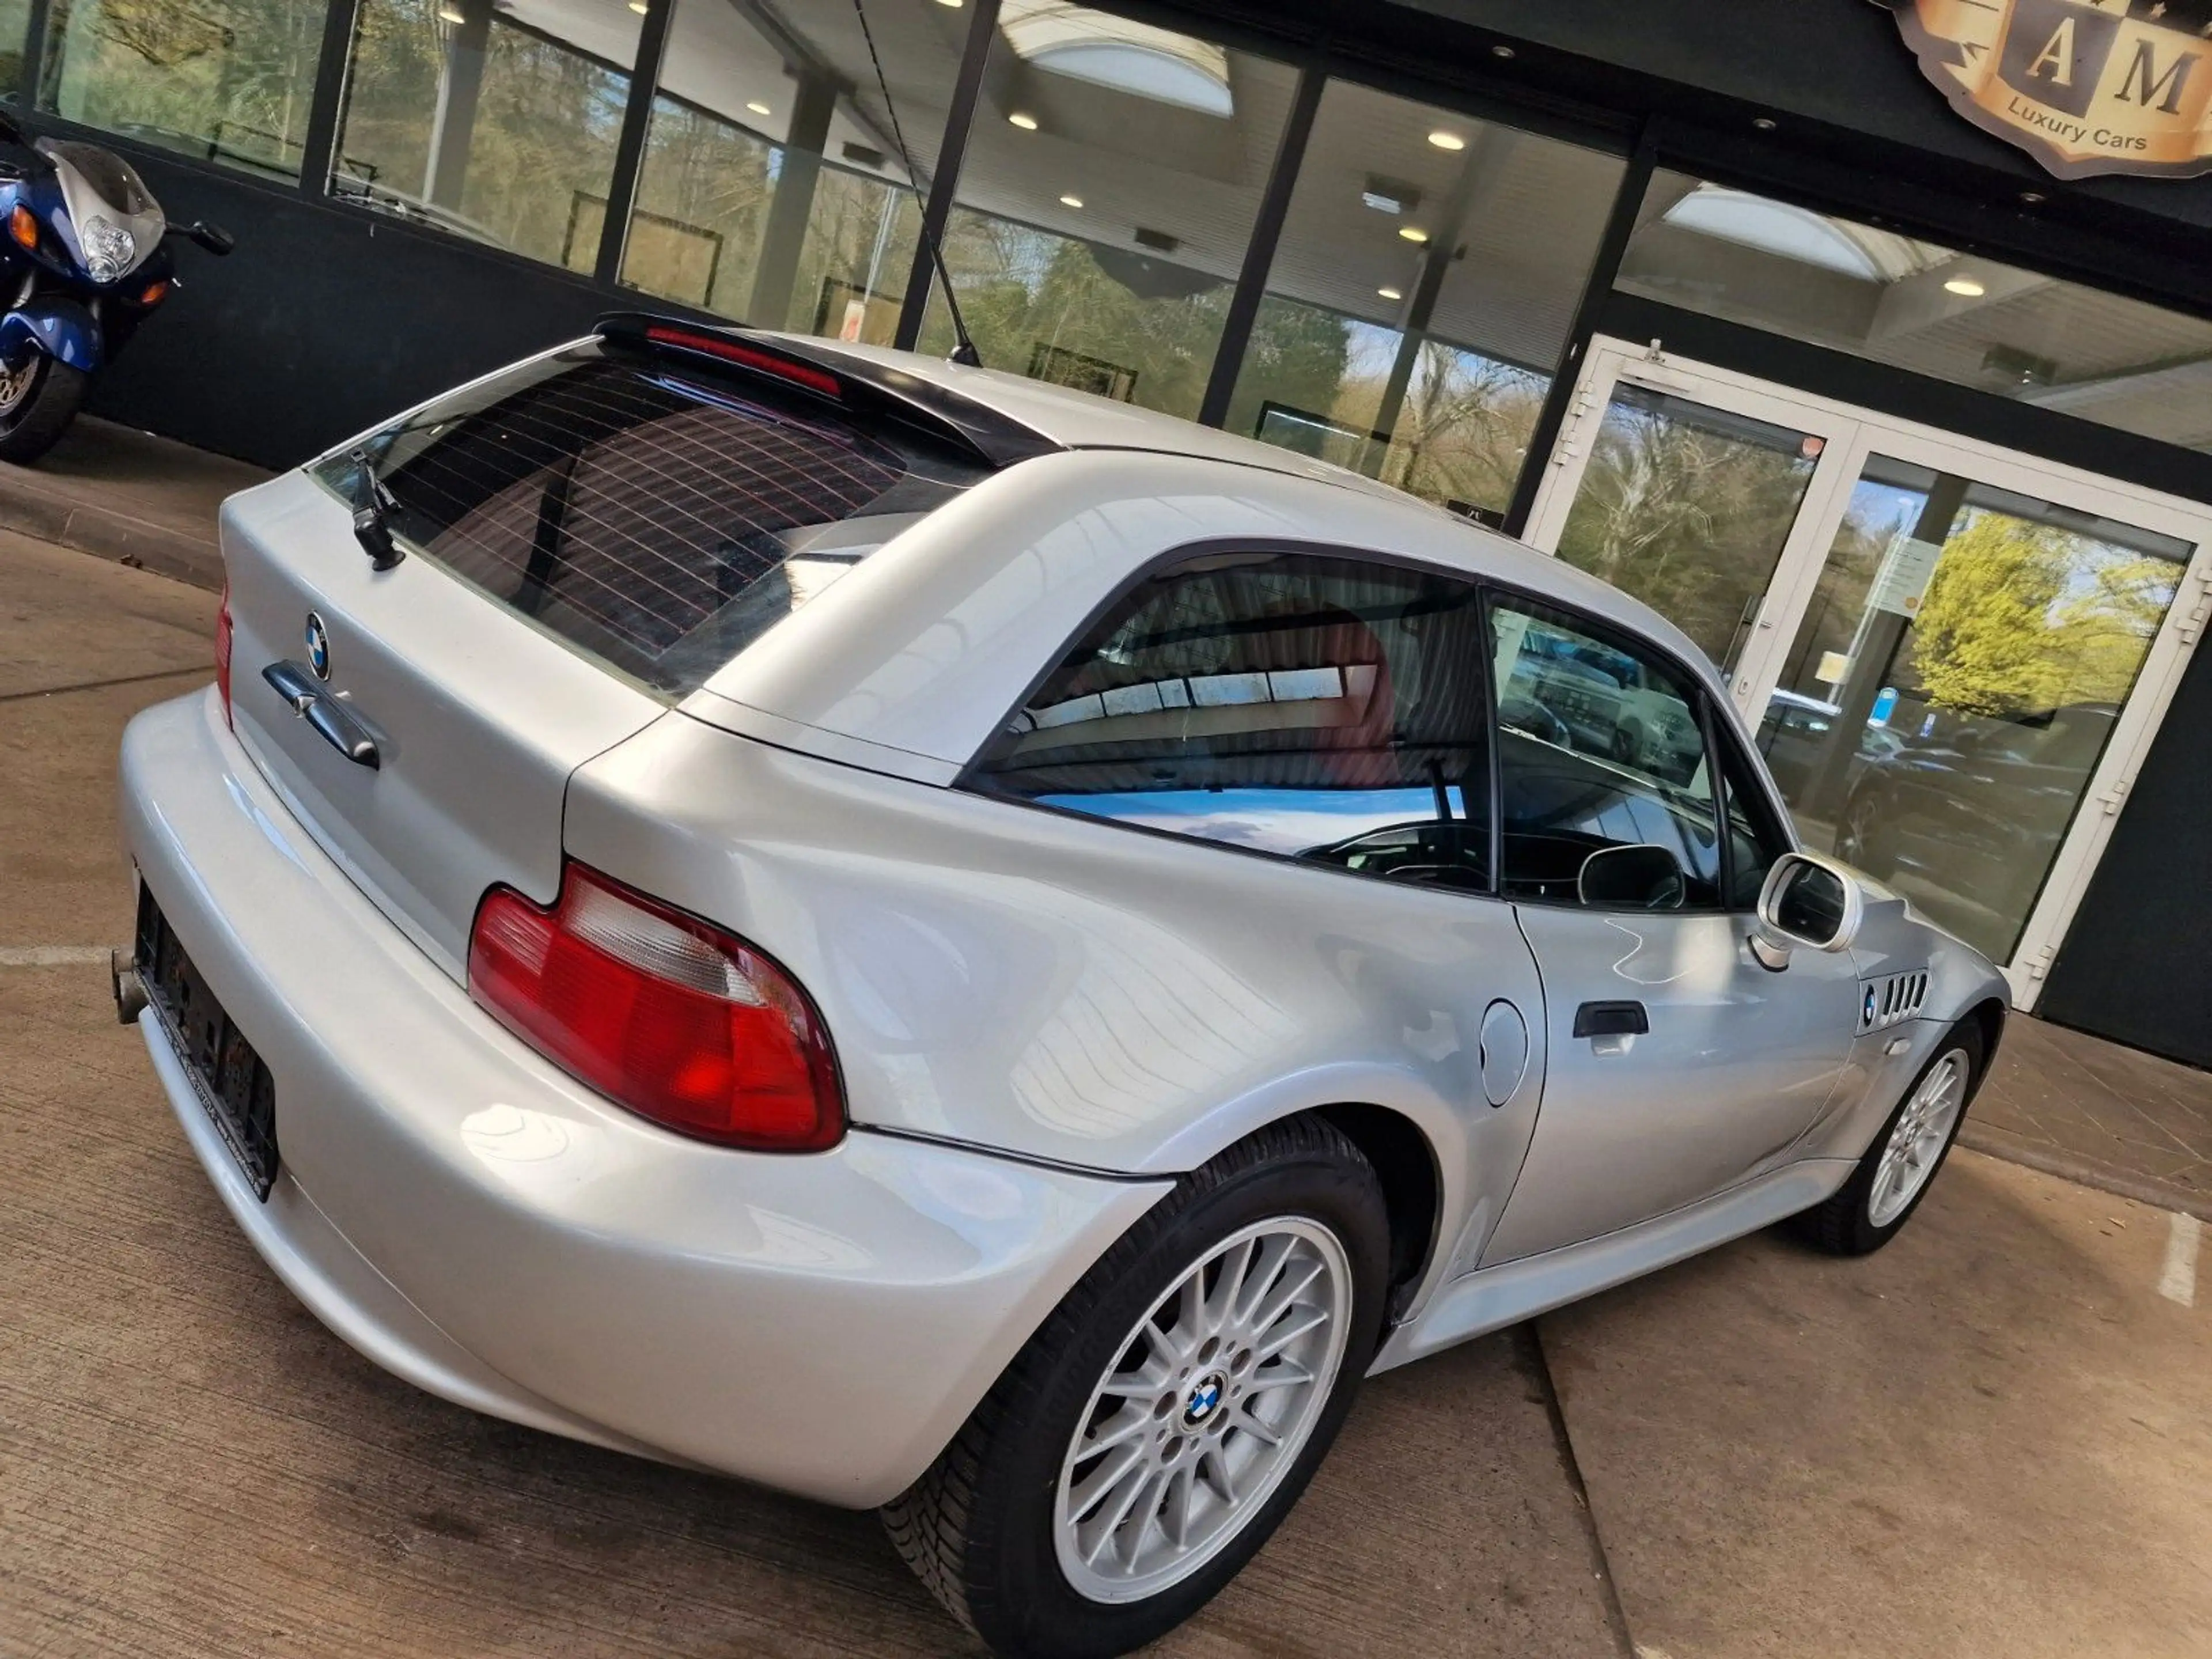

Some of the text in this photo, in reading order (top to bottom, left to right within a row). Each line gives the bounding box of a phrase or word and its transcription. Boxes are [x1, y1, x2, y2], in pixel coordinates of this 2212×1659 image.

[2025, 16, 2203, 116] A M
[2008, 96, 2148, 151] Luxury Cars
